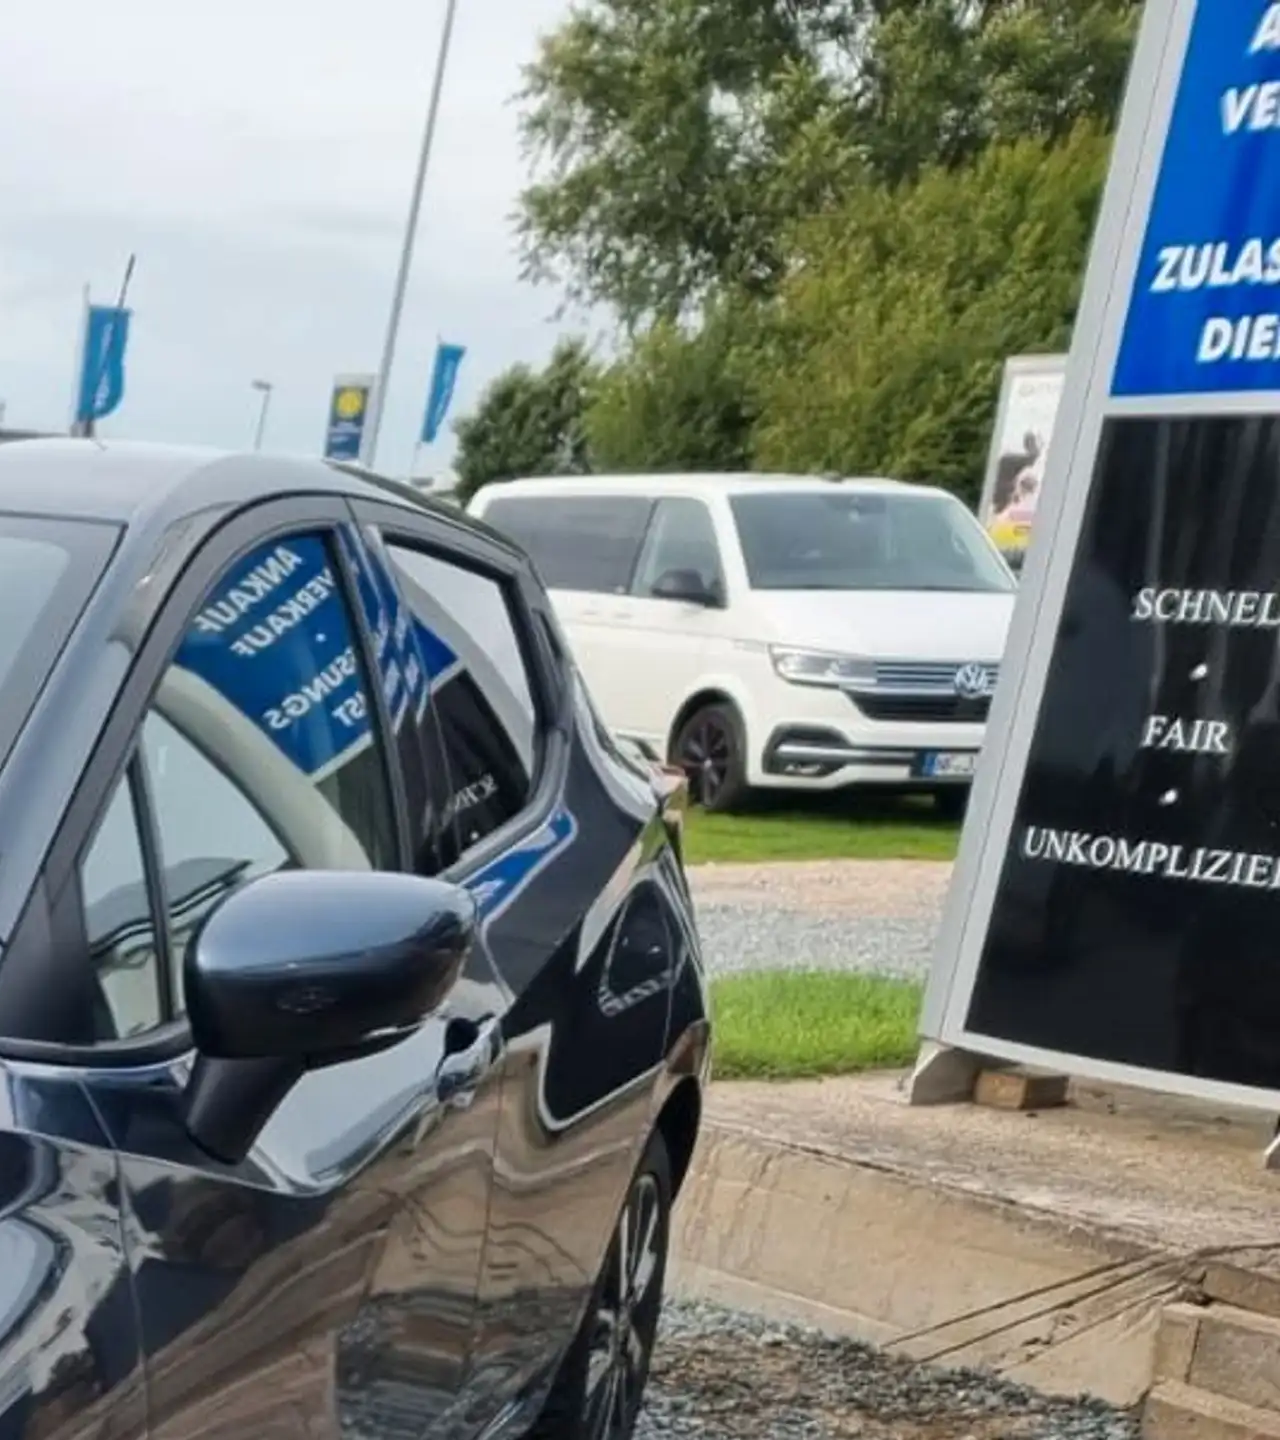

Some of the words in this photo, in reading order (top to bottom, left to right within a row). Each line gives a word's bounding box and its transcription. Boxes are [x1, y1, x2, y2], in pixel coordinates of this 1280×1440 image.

[1222, 82, 1280, 134] VE
[1150, 238, 1280, 292] ZULAS
[1195, 313, 1280, 364] DIE
[1131, 587, 1280, 627] SCHNEL
[1141, 715, 1230, 752] FAIR
